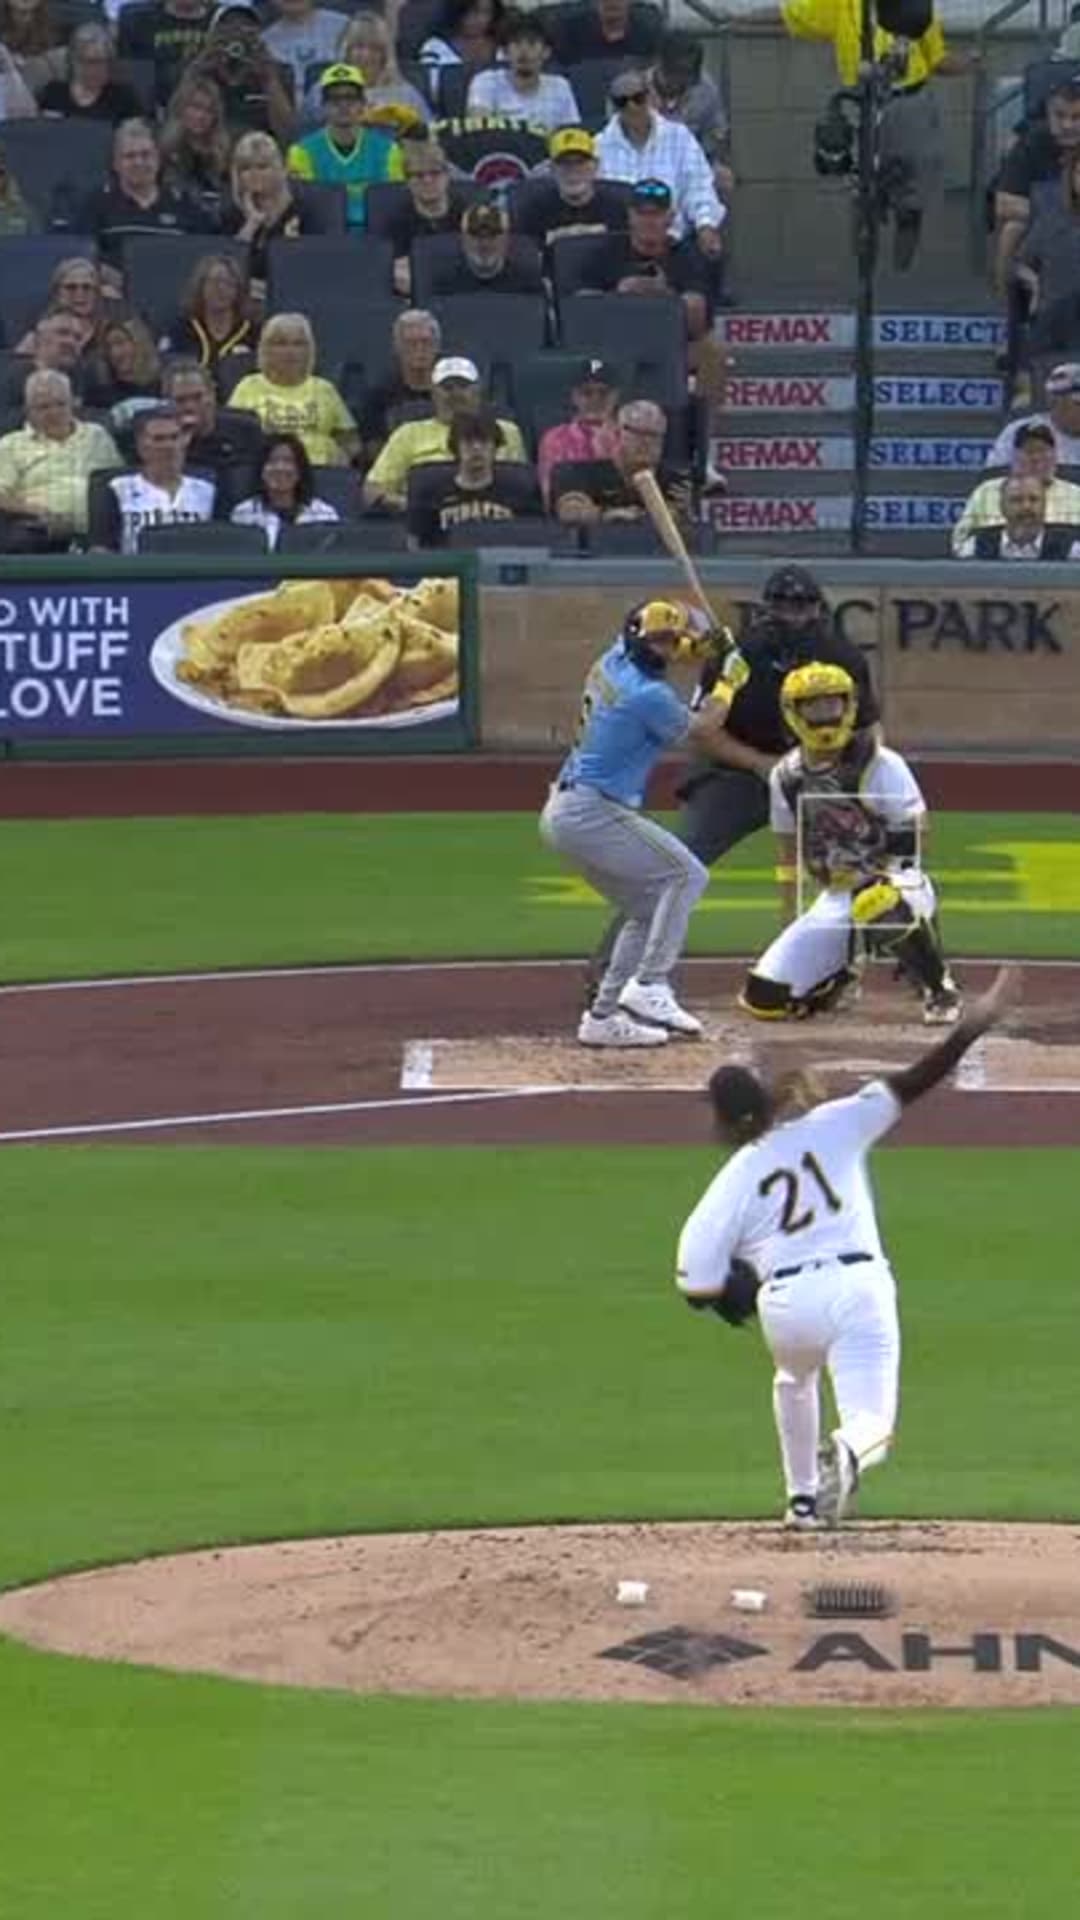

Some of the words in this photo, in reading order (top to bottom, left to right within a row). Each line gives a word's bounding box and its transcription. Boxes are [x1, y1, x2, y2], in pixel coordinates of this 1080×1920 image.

[725, 318, 832, 342] REMAX
[880, 318, 1008, 343] SELECT
[876, 380, 1000, 406] SELECT
[863, 501, 967, 525] SELEC
[28, 596, 129, 626] WITH
[893, 598, 1064, 654] PARK
[0, 677, 123, 719] OVE
[757, 1151, 842, 1235] 21
[788, 1632, 1080, 1672] AHN
